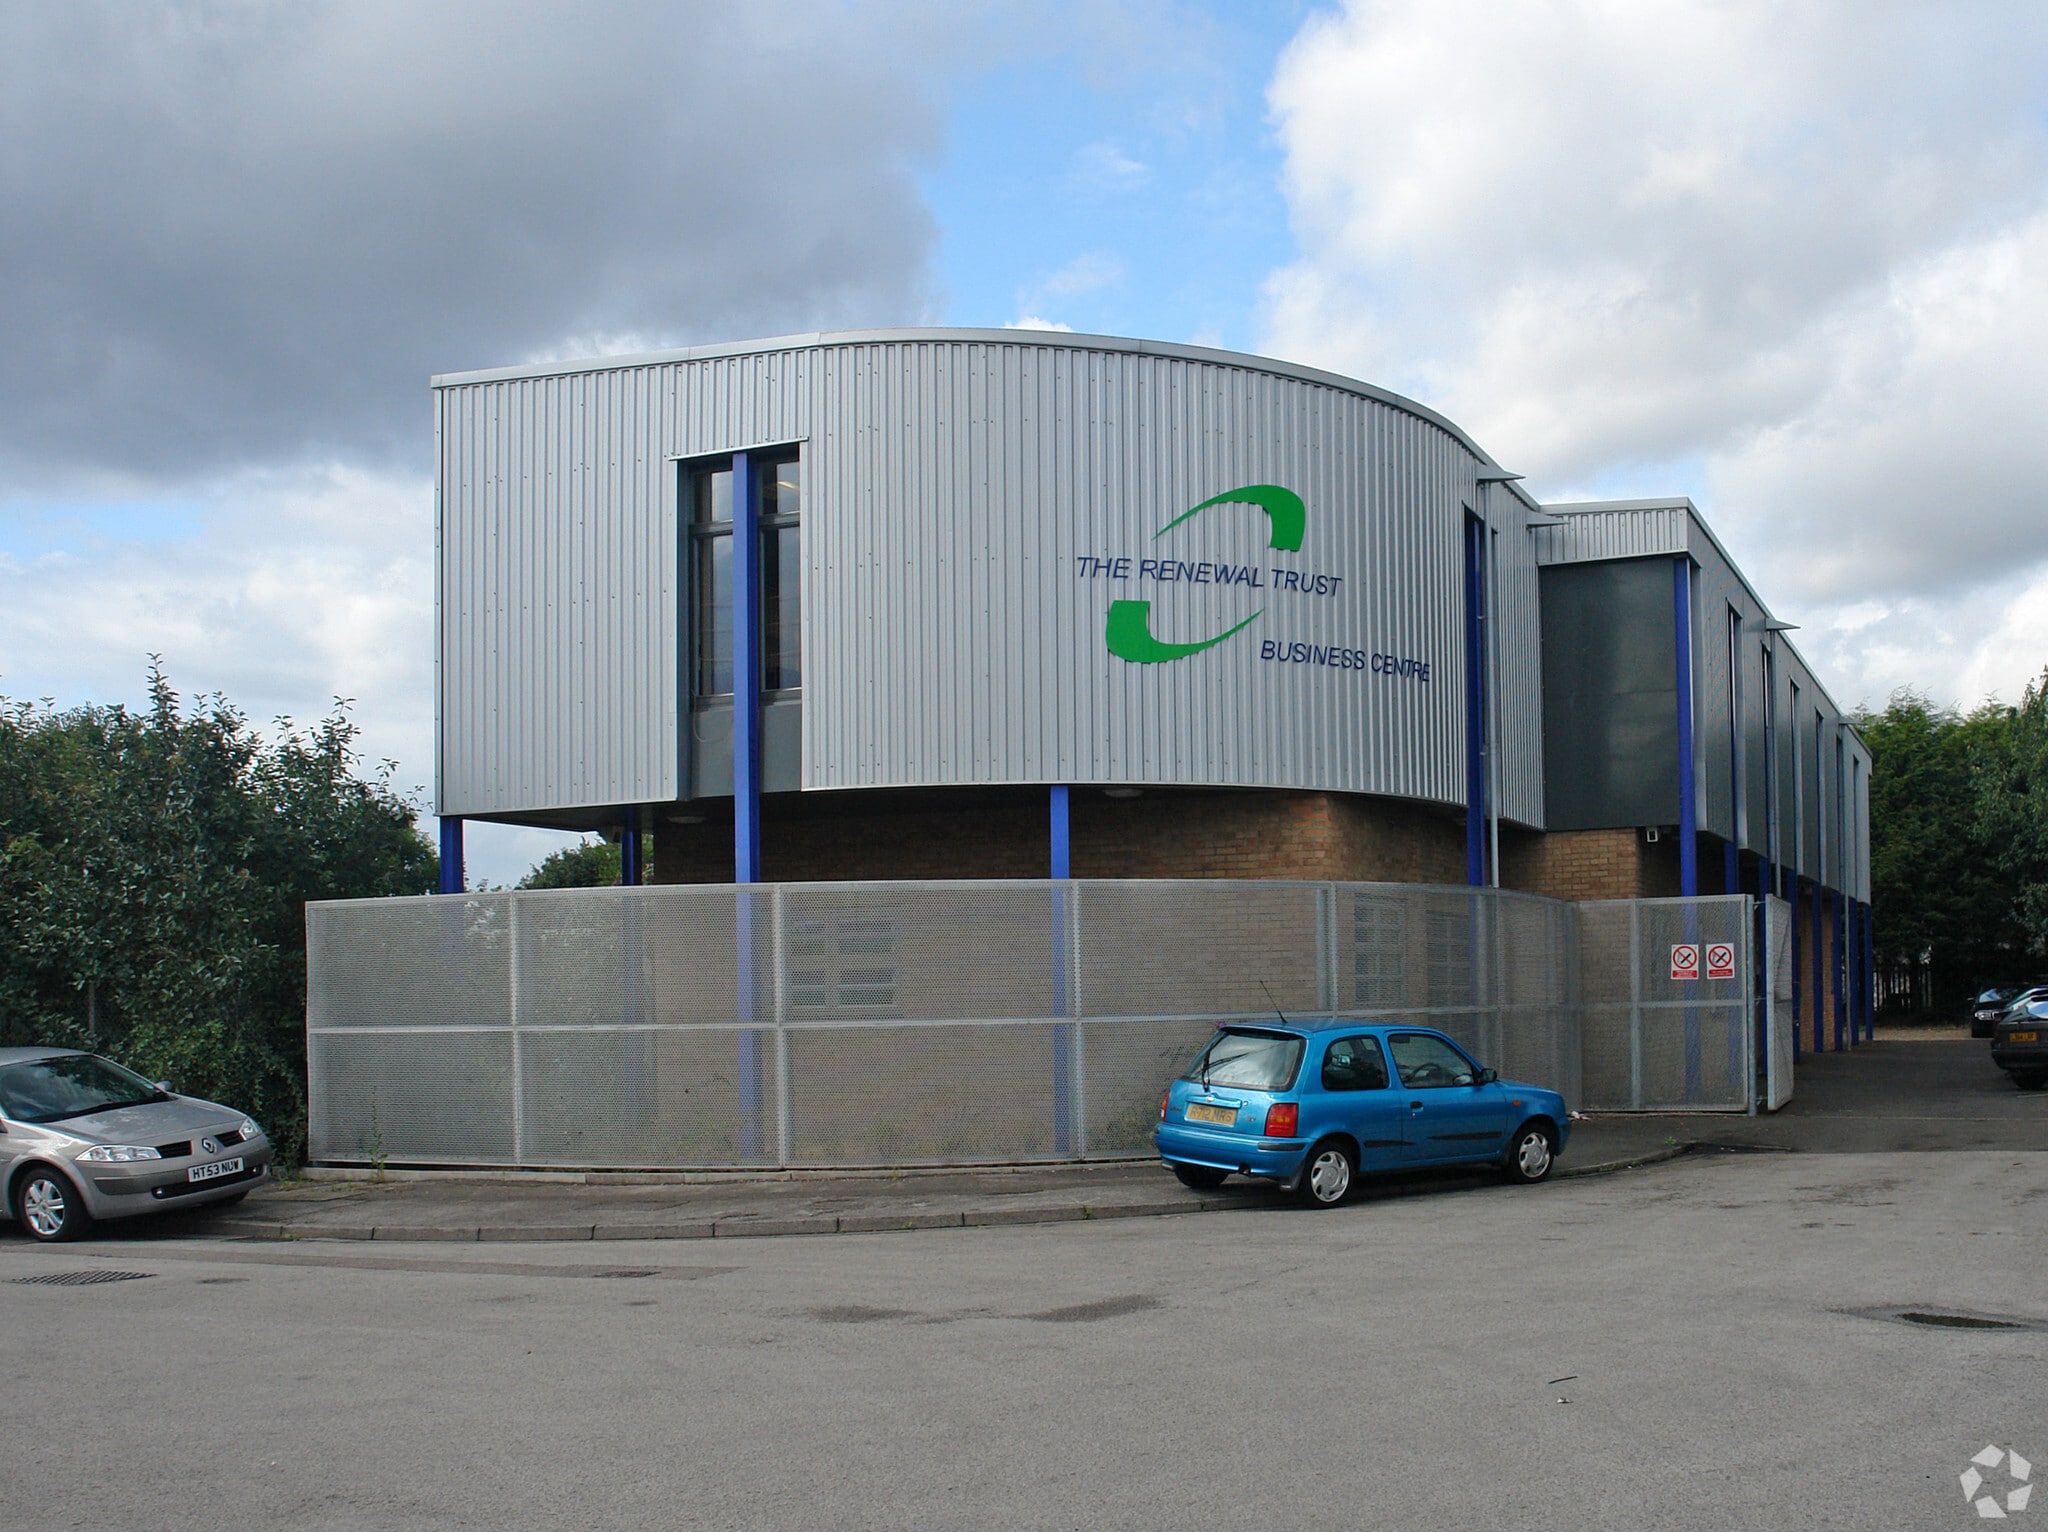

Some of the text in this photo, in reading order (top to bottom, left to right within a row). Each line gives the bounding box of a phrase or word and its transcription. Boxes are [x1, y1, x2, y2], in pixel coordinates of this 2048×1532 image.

[1077, 556, 1342, 597] THE RENEWAL TRUST
[1260, 640, 1431, 682] BUSINESS CENTRE
[193, 1164, 220, 1179] HT53
